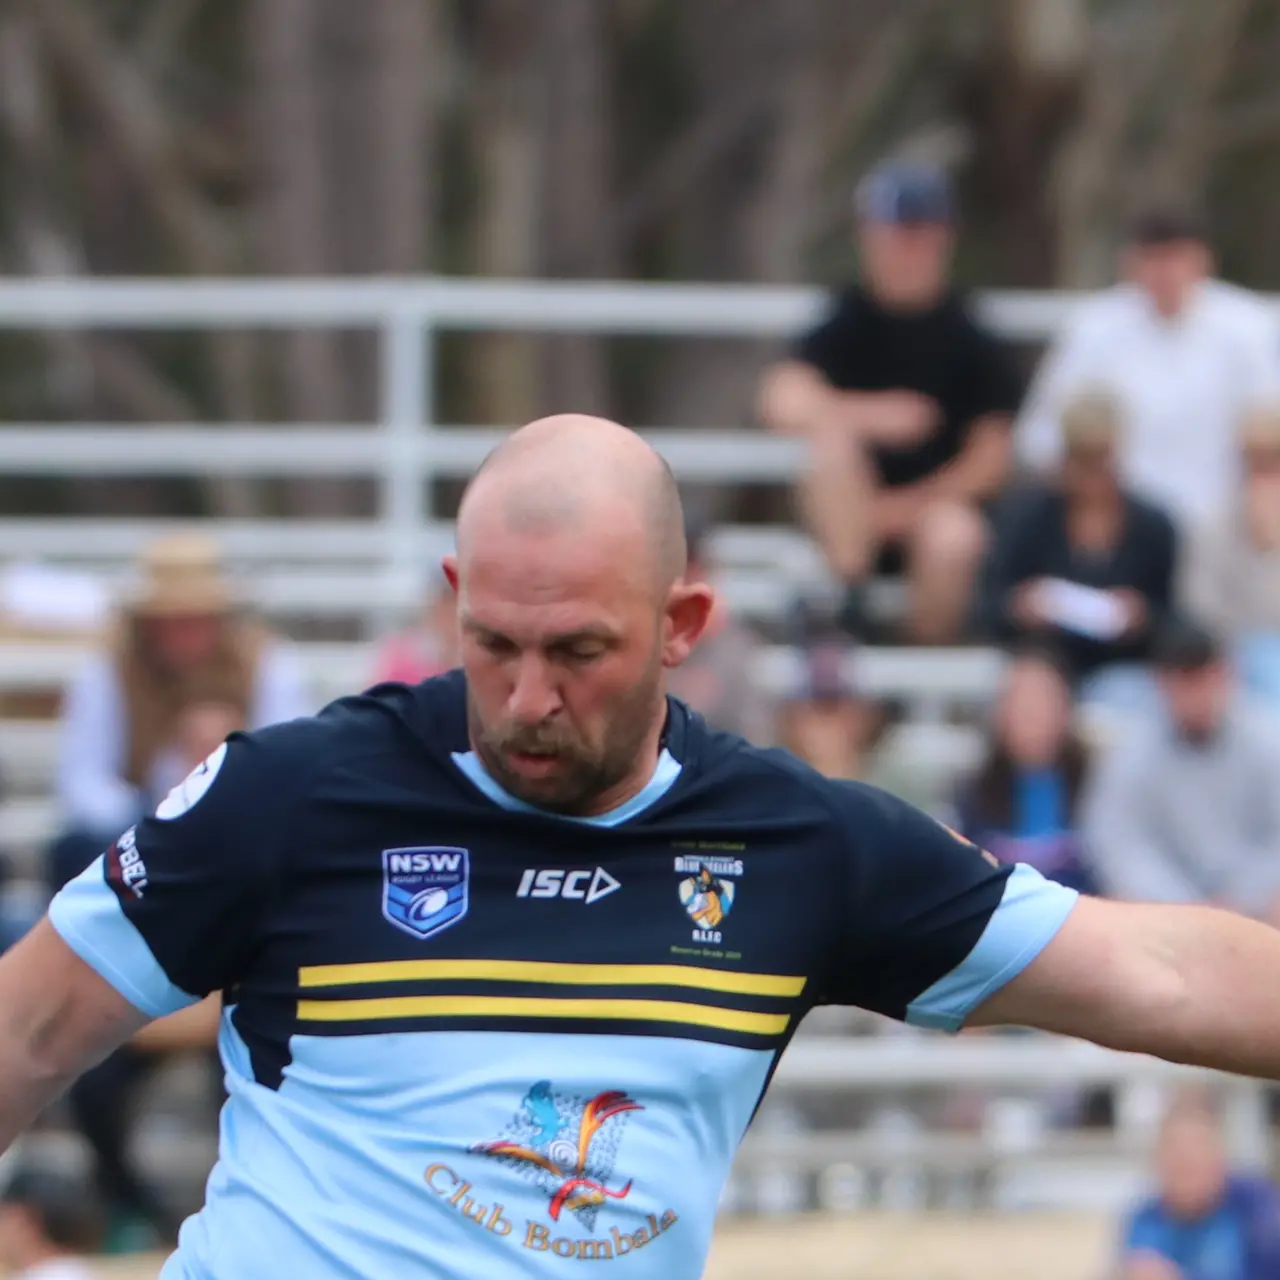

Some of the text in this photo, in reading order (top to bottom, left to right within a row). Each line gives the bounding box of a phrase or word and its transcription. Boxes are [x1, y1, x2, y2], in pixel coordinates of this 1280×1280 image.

[389, 854, 462, 873] NSW
[516, 869, 592, 899] ISC
[424, 1163, 679, 1260] Club Bombala
